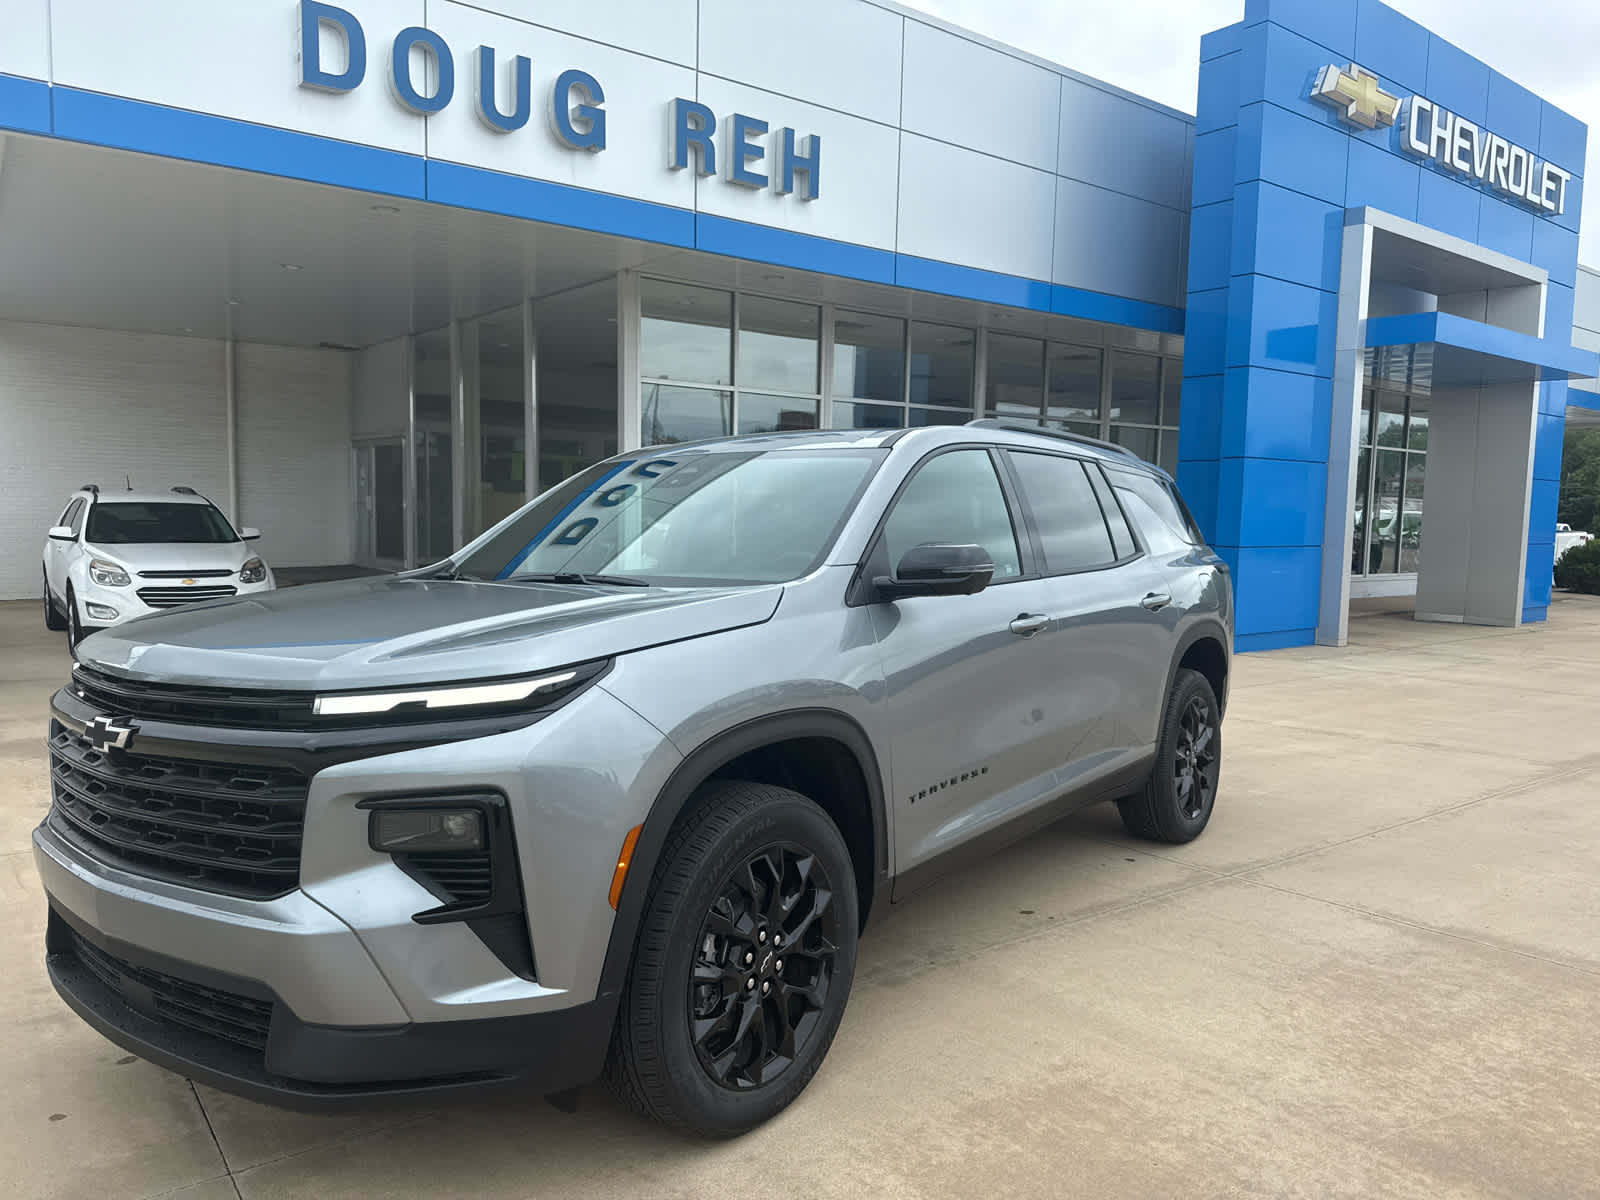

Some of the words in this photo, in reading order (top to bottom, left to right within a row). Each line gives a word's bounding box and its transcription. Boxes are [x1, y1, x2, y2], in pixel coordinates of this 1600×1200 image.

[298, 0, 607, 153] DOUG
[668, 97, 821, 201] REH
[1404, 94, 1571, 216] CHEVROLET
[908, 766, 989, 804] TRAVERSE
